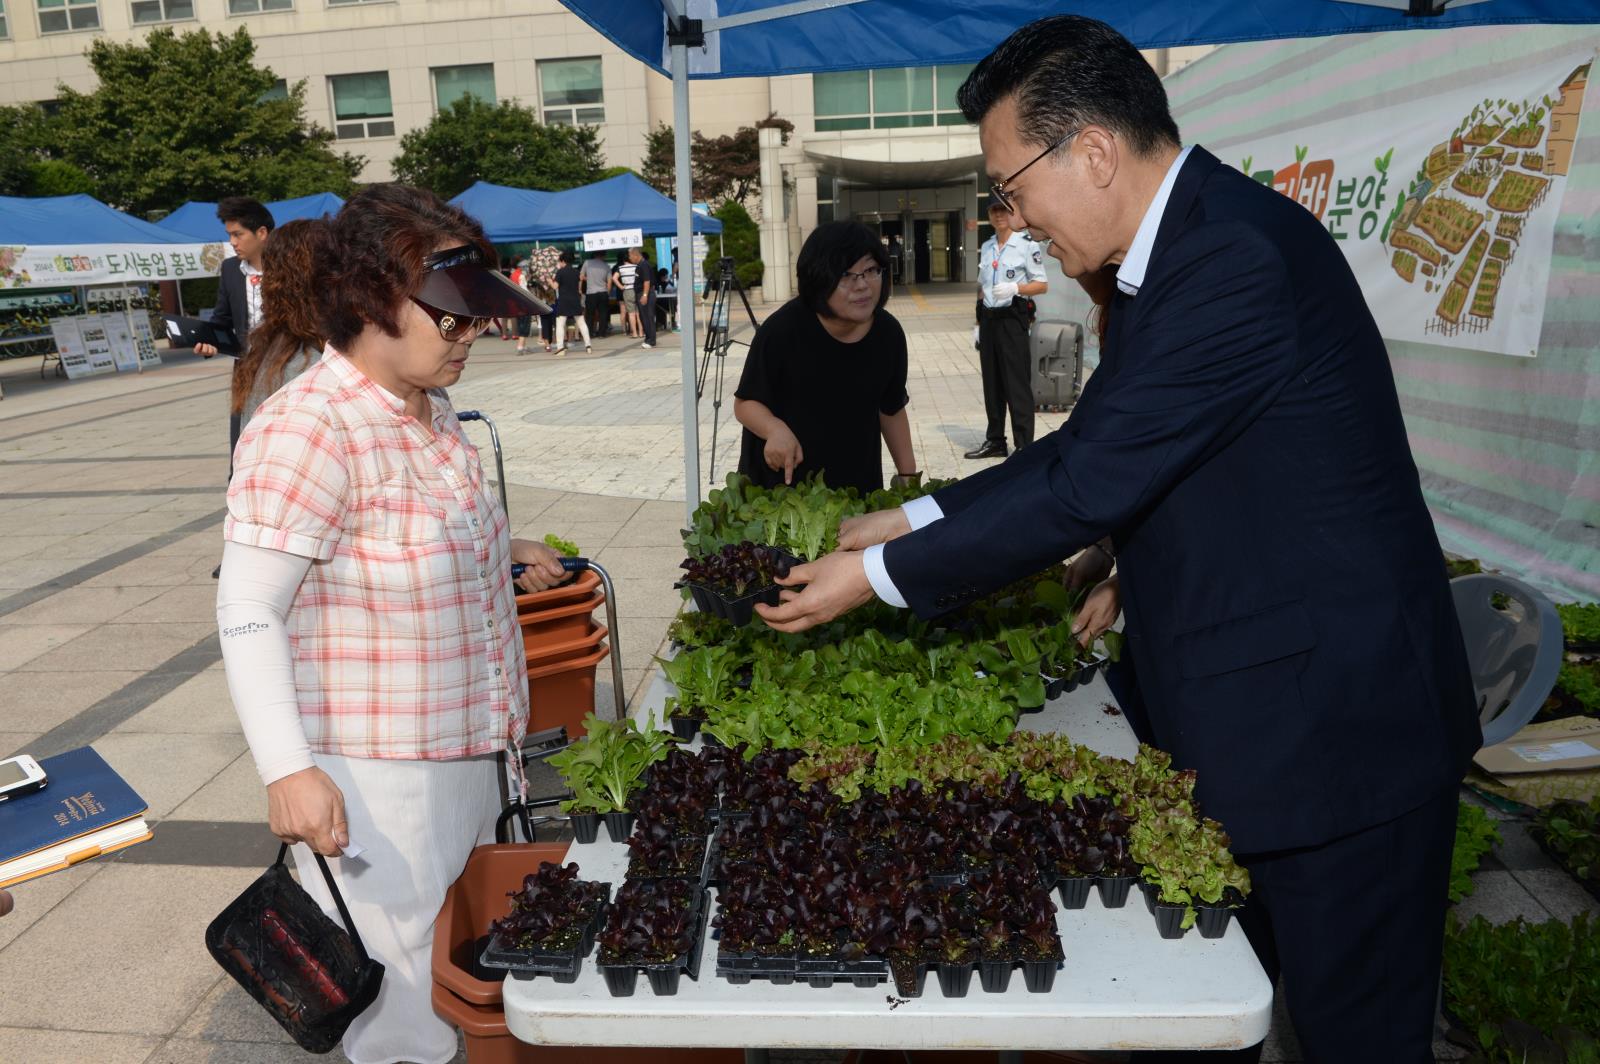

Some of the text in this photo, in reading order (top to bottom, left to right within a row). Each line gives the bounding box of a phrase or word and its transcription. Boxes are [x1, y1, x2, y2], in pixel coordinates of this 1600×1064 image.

[1328, 172, 1388, 240] 분양
[106, 251, 168, 277] 도시농업
[171, 252, 198, 277] 홍보
